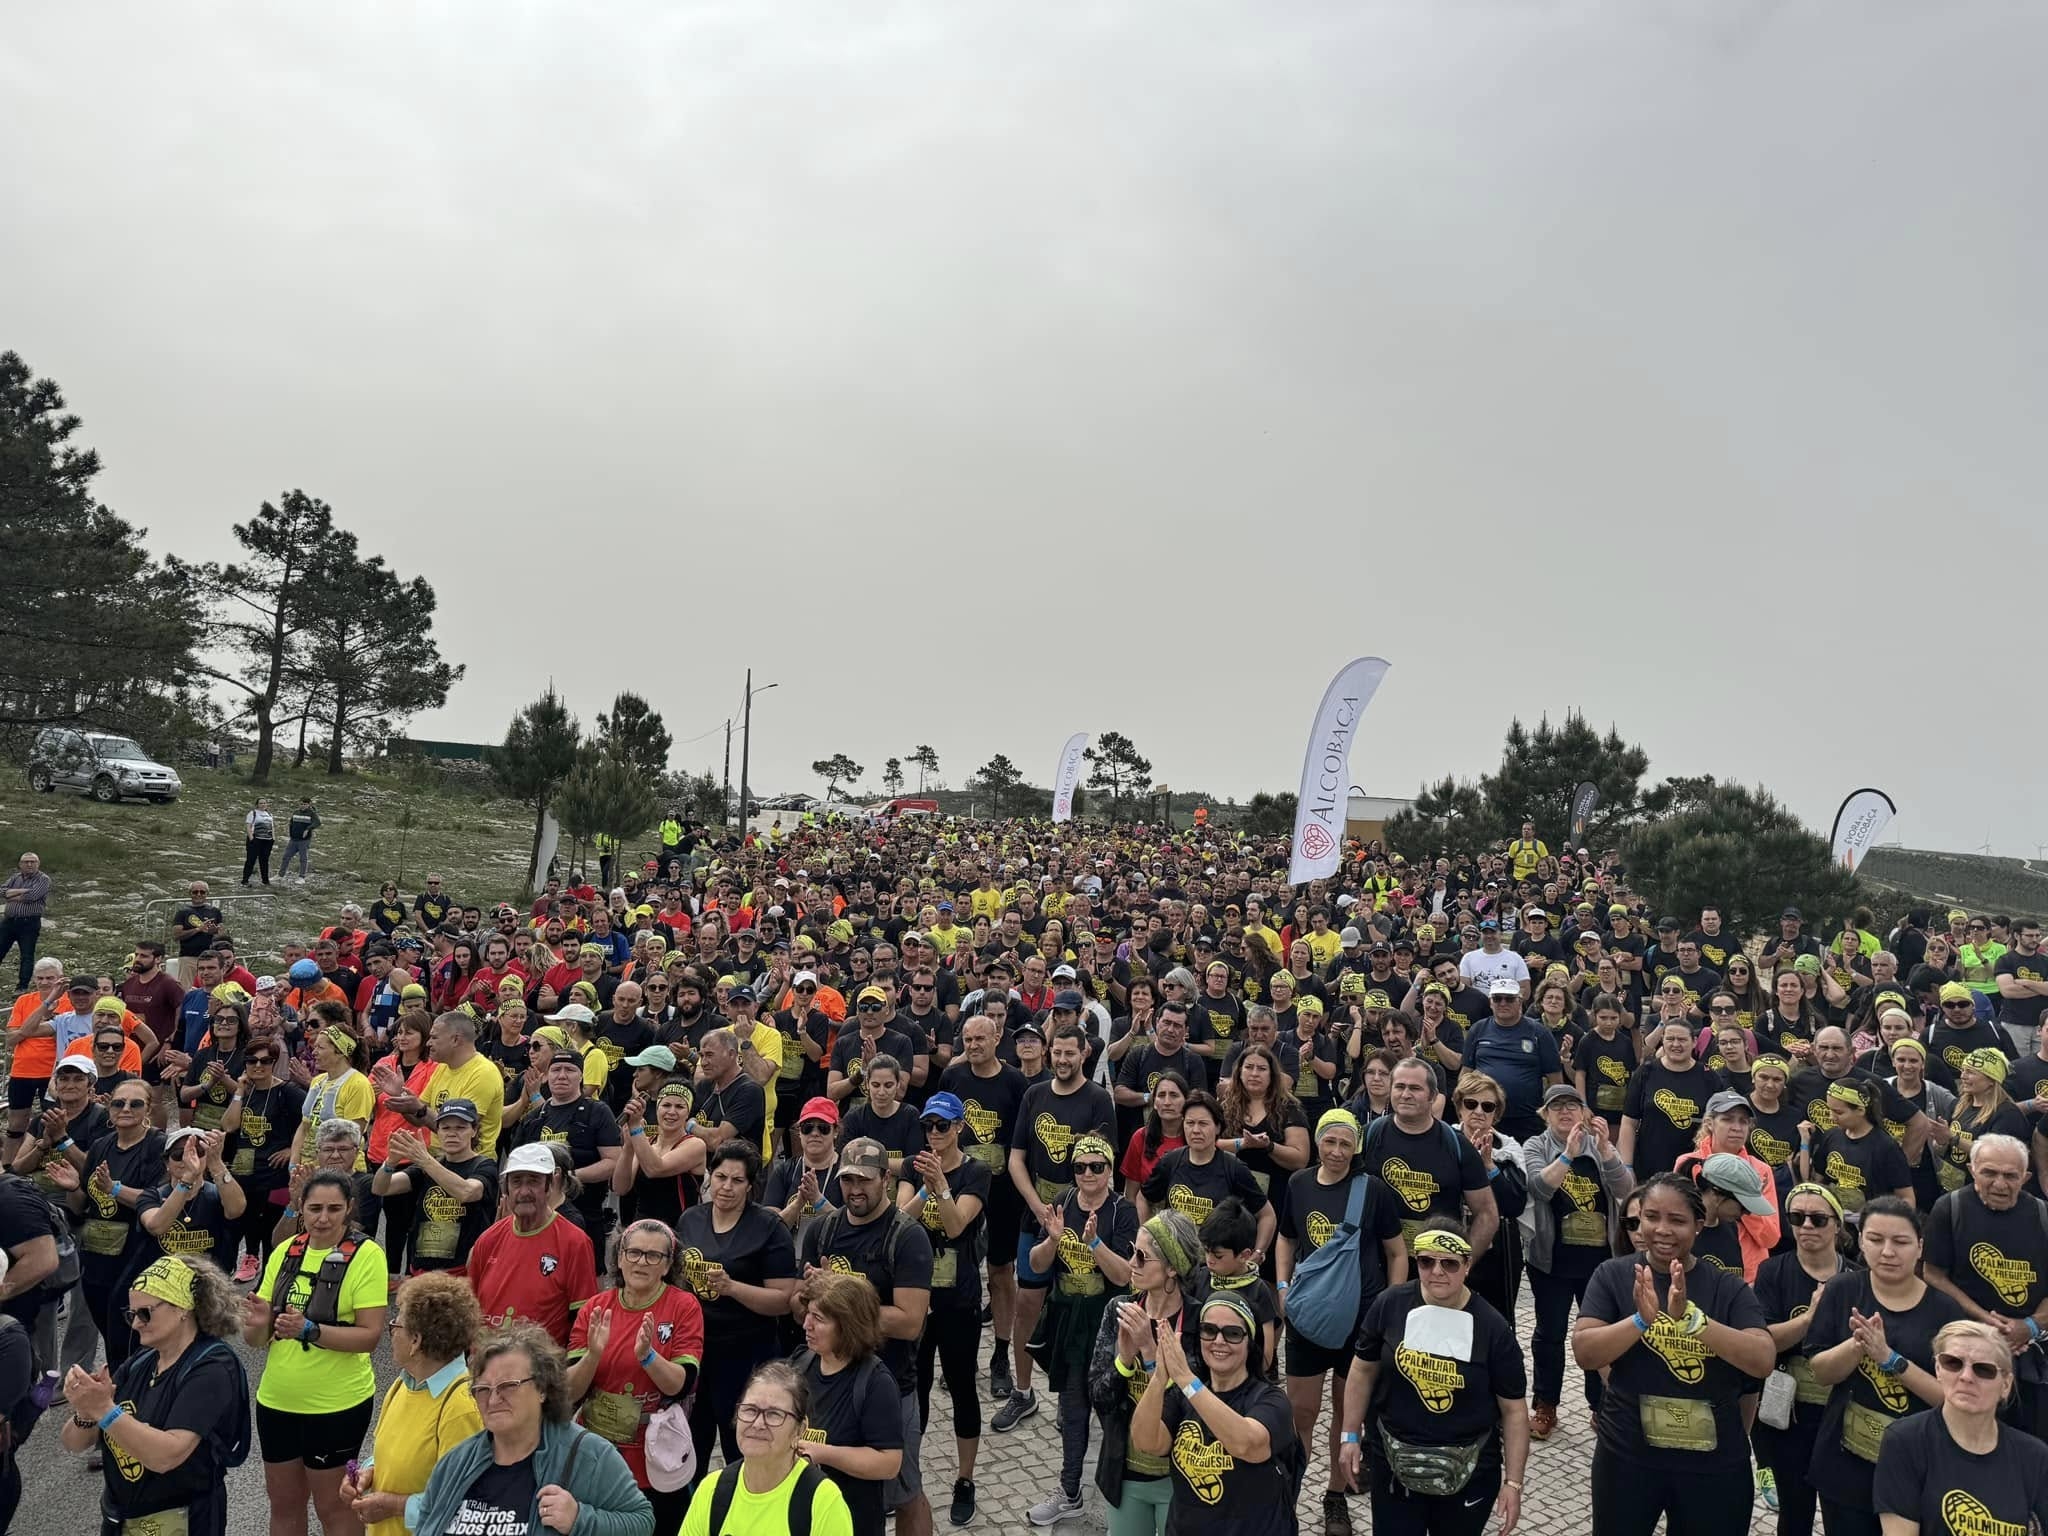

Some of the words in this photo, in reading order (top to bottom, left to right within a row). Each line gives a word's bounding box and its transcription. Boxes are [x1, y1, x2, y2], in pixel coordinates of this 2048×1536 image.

[1310, 697, 1358, 824] ALCOBAÇA
[1390, 1170, 1432, 1184] PALMILHAR
[1402, 1180, 1439, 1192] FREGUESIA
[1980, 1257, 2029, 1272] PALMILHAR
[1995, 1269, 2036, 1281] FREGUESIA
[1404, 1353, 1455, 1374] PALMILHAR
[1417, 1368, 1464, 1387] FREGUESIA
[1178, 1439, 1222, 1456] PALMILHAR
[1187, 1454, 1233, 1468] FREGUESIA
[467, 1499, 489, 1511] TRAIL
[461, 1509, 516, 1524] BRUTOS
[456, 1523, 485, 1535] DOS
